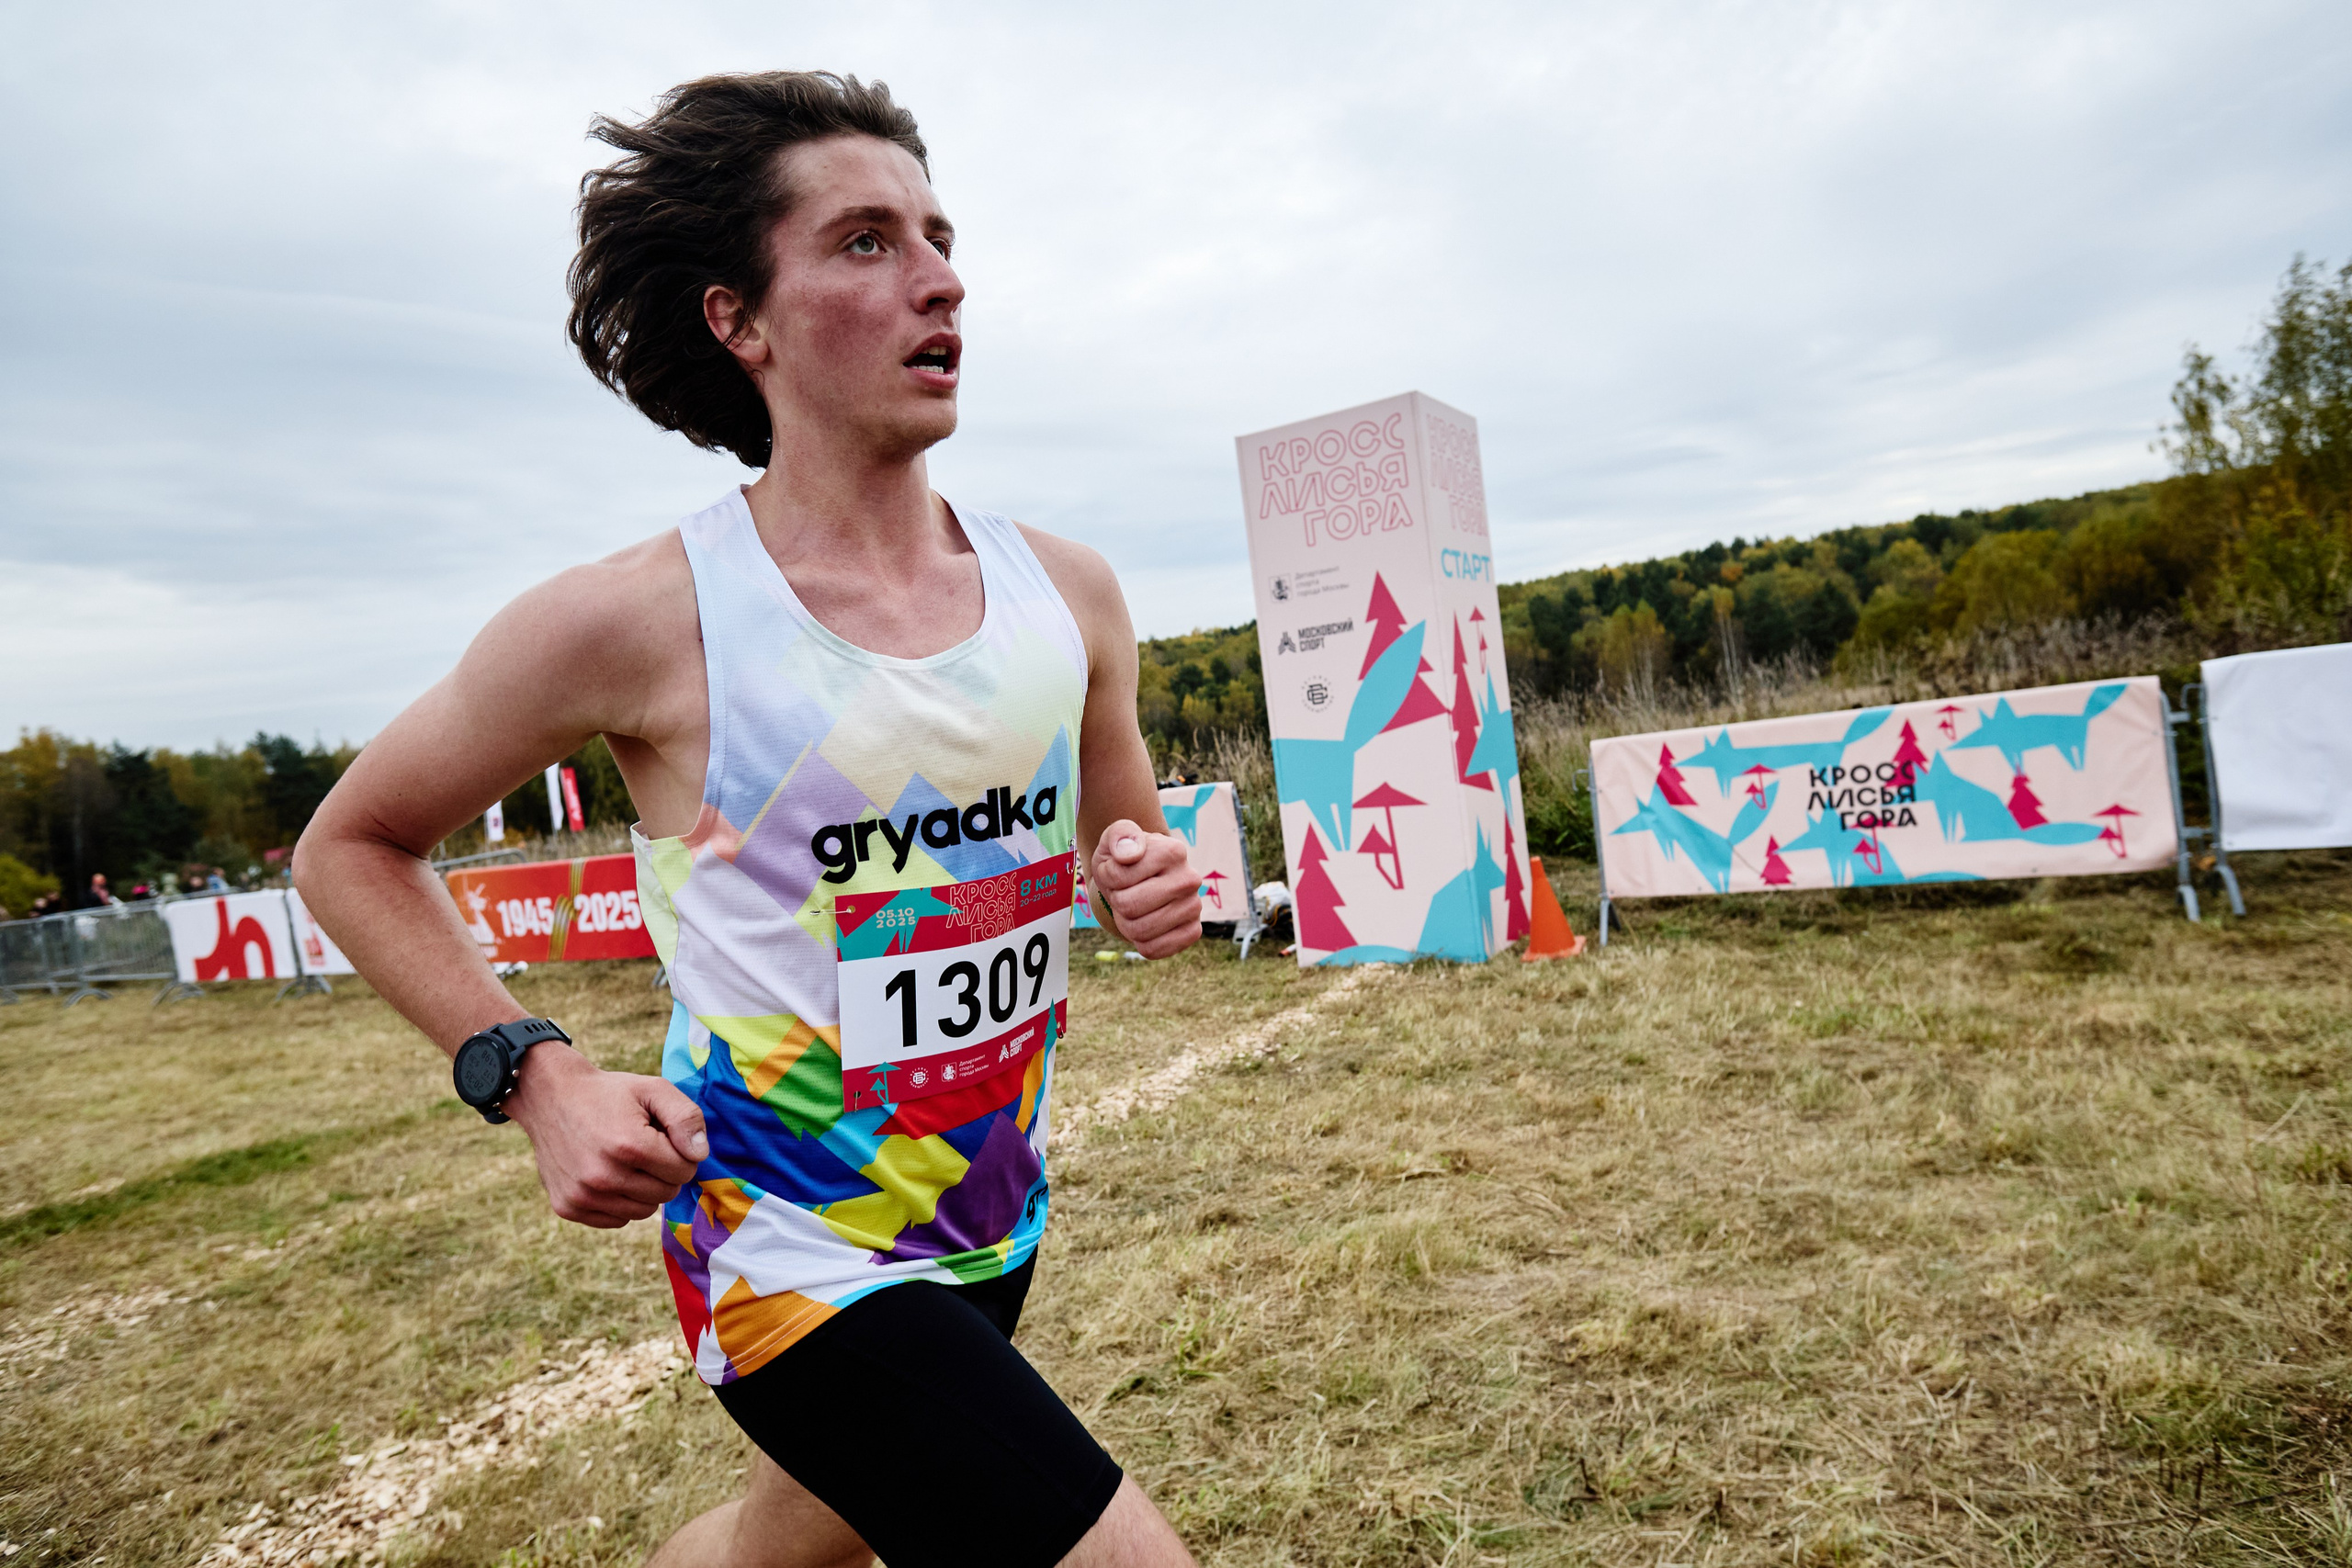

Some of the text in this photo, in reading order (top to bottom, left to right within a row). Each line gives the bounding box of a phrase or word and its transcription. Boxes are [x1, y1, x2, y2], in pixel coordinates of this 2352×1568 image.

[1259, 412, 1405, 481] КРОСС
[1260, 451, 1409, 519] ЛИСЬЯ
[1303, 492, 1414, 547] ГОРА
[1441, 547, 1490, 582] СТАРТ
[1809, 760, 1915, 787] КРОСС
[1808, 784, 1917, 810] ЛИСЬЯ
[1840, 807, 1918, 832] ГОРА
[810, 784, 1057, 885] gryadka
[949, 872, 1017, 907] КРОСС
[1020, 879, 1032, 897] 8
[1042, 888, 1057, 899] года
[496, 889, 643, 937] 1945 2025
[876, 907, 914, 919] 05.10
[876, 916, 916, 929] 2025
[945, 892, 1016, 929] ЛИСЬЯ
[970, 913, 1016, 943] ГОРА
[885, 931, 1050, 1047] 1309
[958, 1055, 986, 1067] Департамент
[958, 1065, 975, 1073] спорта
[975, 1064, 989, 1073] Москвы
